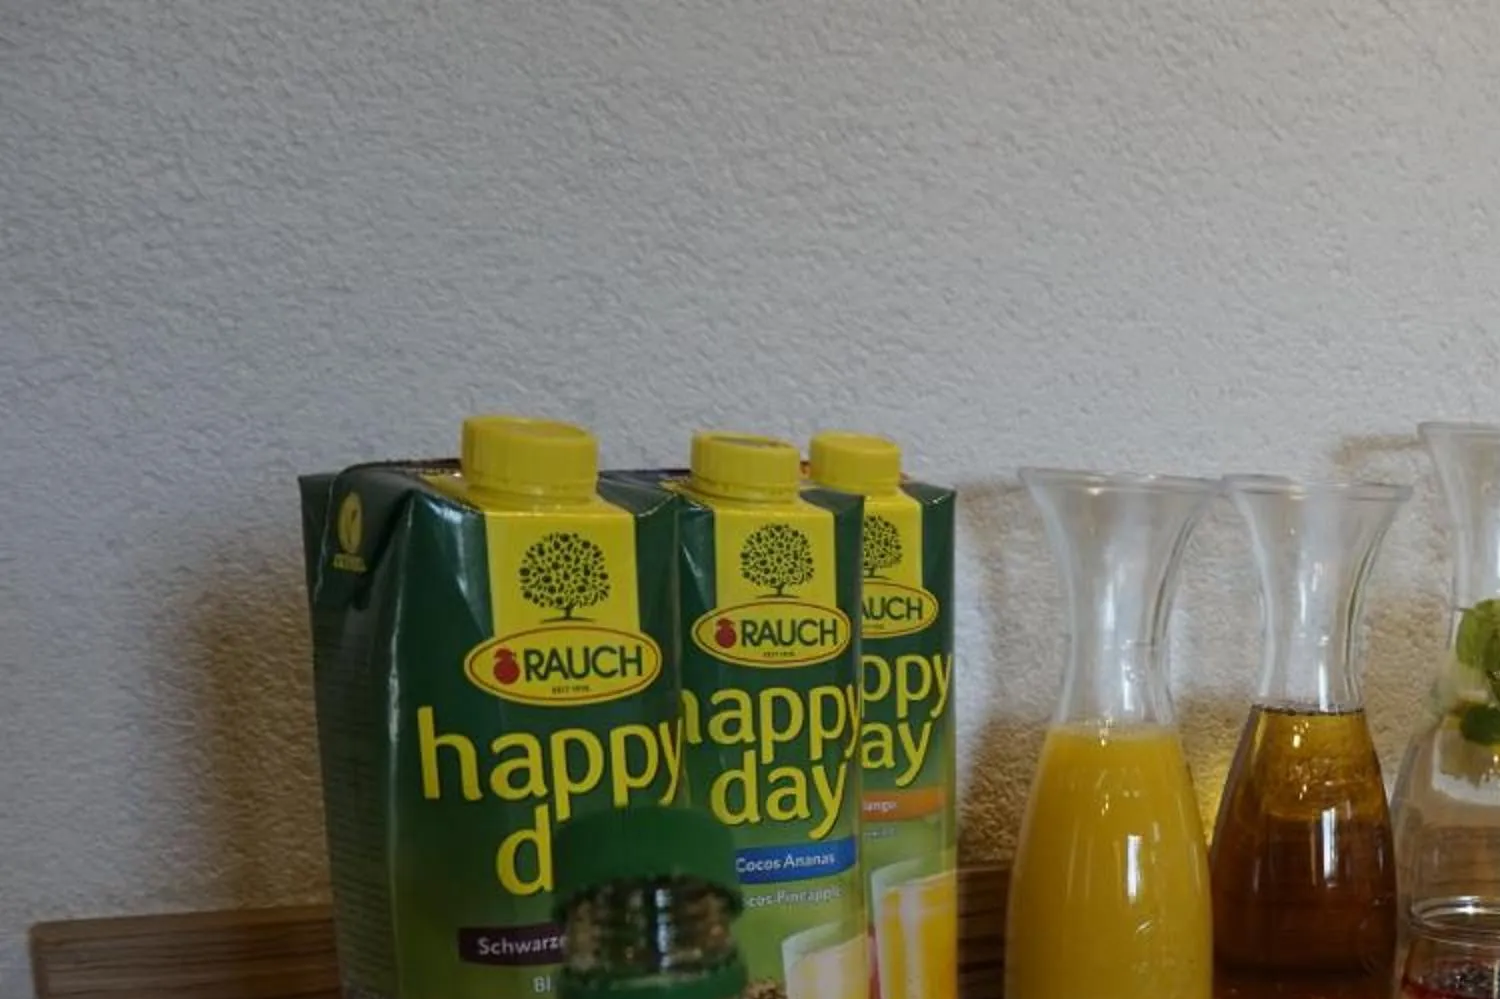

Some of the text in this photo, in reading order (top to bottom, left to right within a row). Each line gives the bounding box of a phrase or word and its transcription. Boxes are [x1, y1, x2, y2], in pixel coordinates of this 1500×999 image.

[741, 618, 838, 648] RAUCH
[861, 596, 924, 620] UCH
[523, 645, 643, 682] RAUCH
[861, 655, 952, 719] ppy
[417, 705, 684, 822] happy
[861, 720, 932, 787] ay
[710, 748, 848, 840] day
[735, 850, 836, 873] Cocos Ananas
